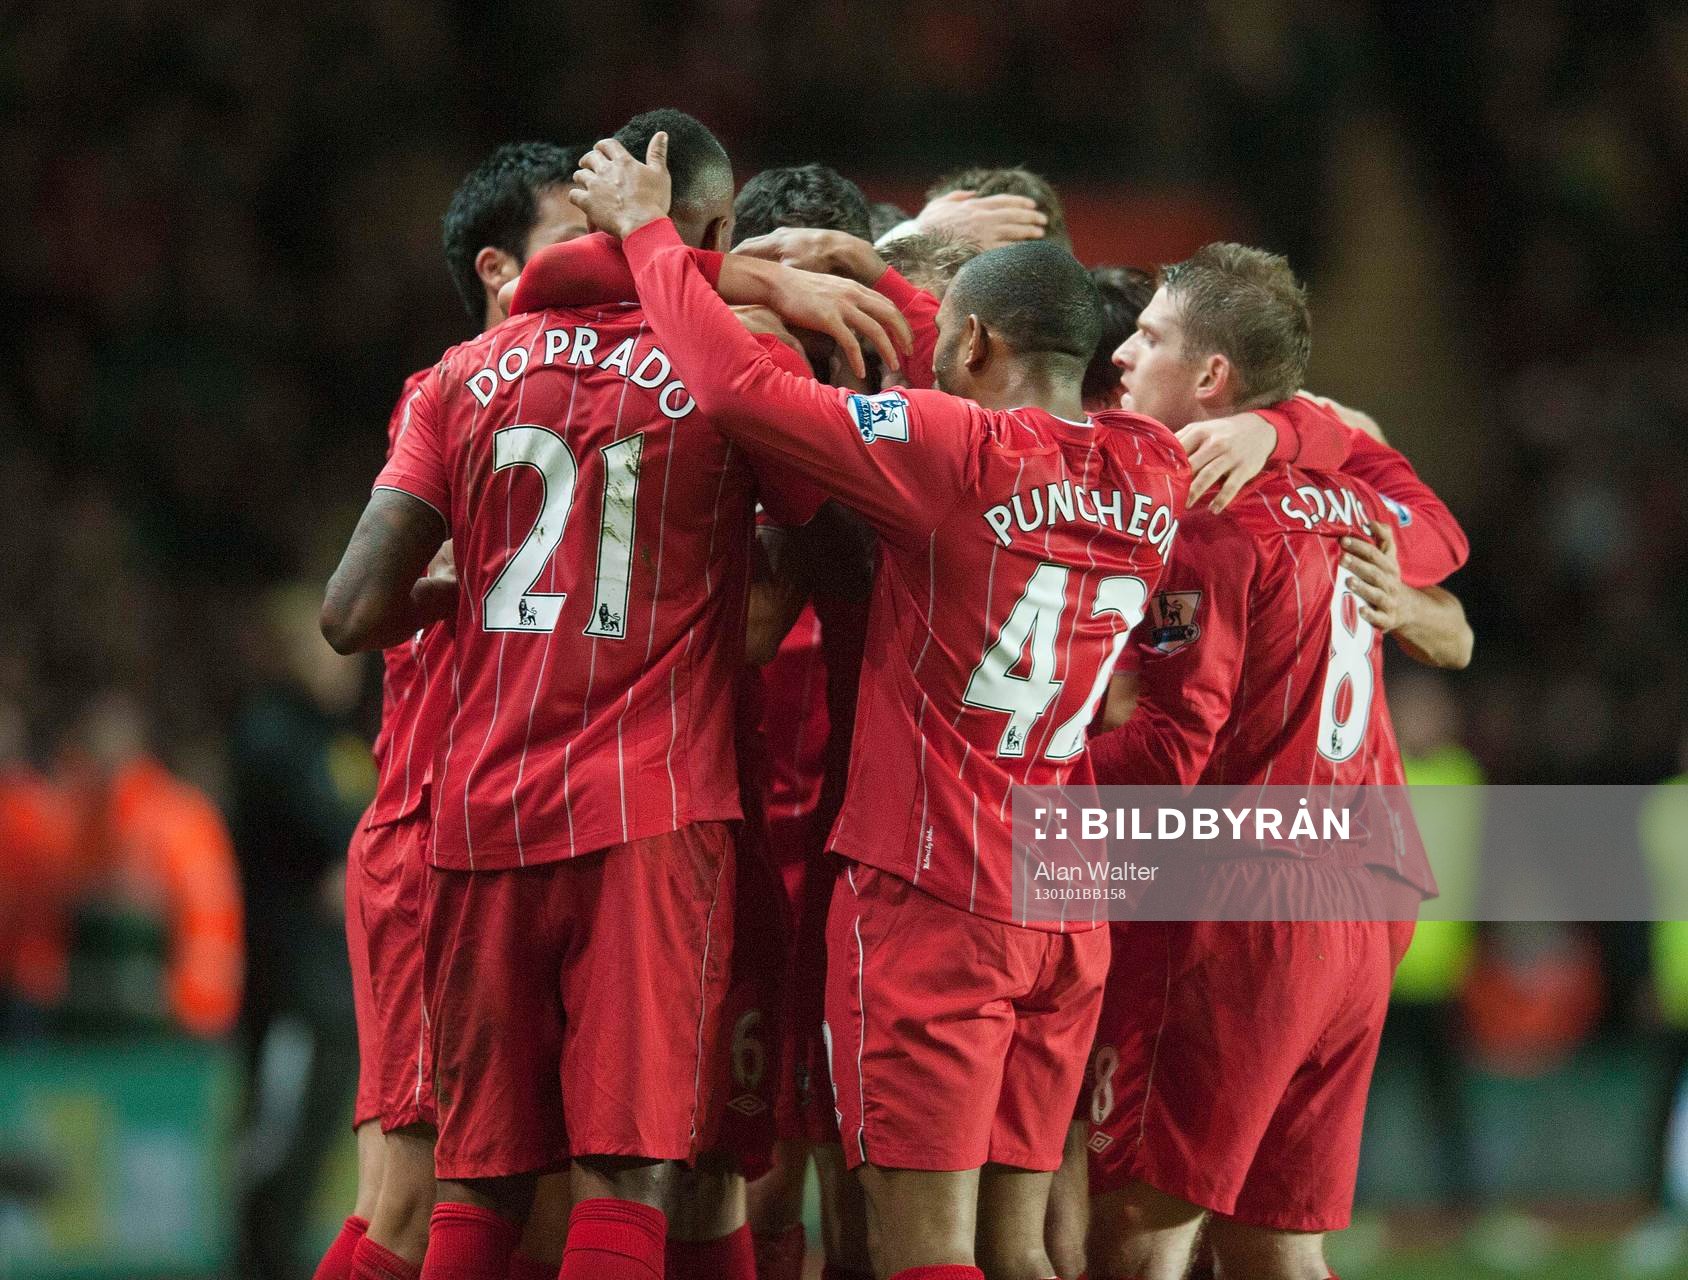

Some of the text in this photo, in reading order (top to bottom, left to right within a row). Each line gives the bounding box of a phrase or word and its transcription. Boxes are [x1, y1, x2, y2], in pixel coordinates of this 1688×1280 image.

[465, 326, 697, 420] DO PRADO
[482, 424, 645, 640] 21
[962, 561, 1148, 760] 42
[1316, 565, 1374, 763] 8
[731, 1008, 764, 1089] 6
[1091, 1045, 1119, 1125] 8
